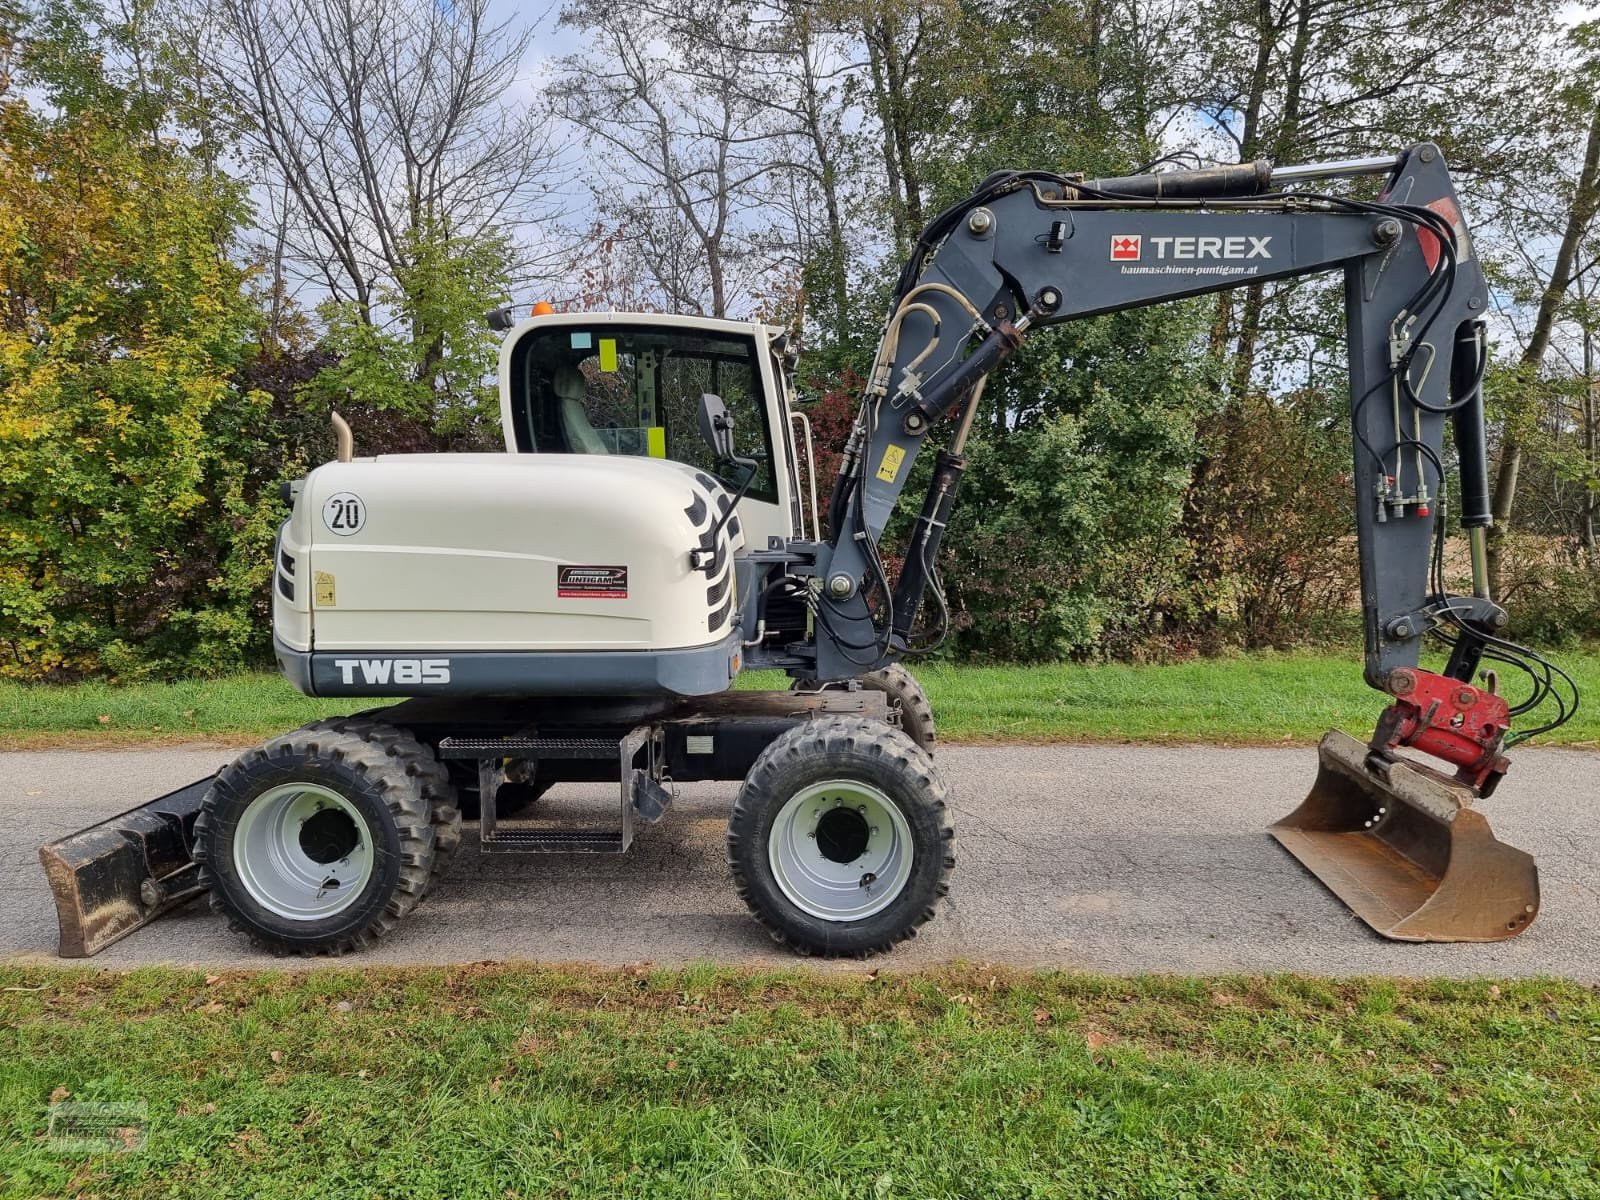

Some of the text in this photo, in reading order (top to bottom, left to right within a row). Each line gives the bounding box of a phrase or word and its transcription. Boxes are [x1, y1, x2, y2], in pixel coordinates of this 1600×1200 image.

[1150, 236, 1273, 259] TEREX
[1121, 264, 1258, 276] baumaschinen-puntigam.at
[331, 499, 359, 529] 20
[335, 659, 451, 685] TW85
